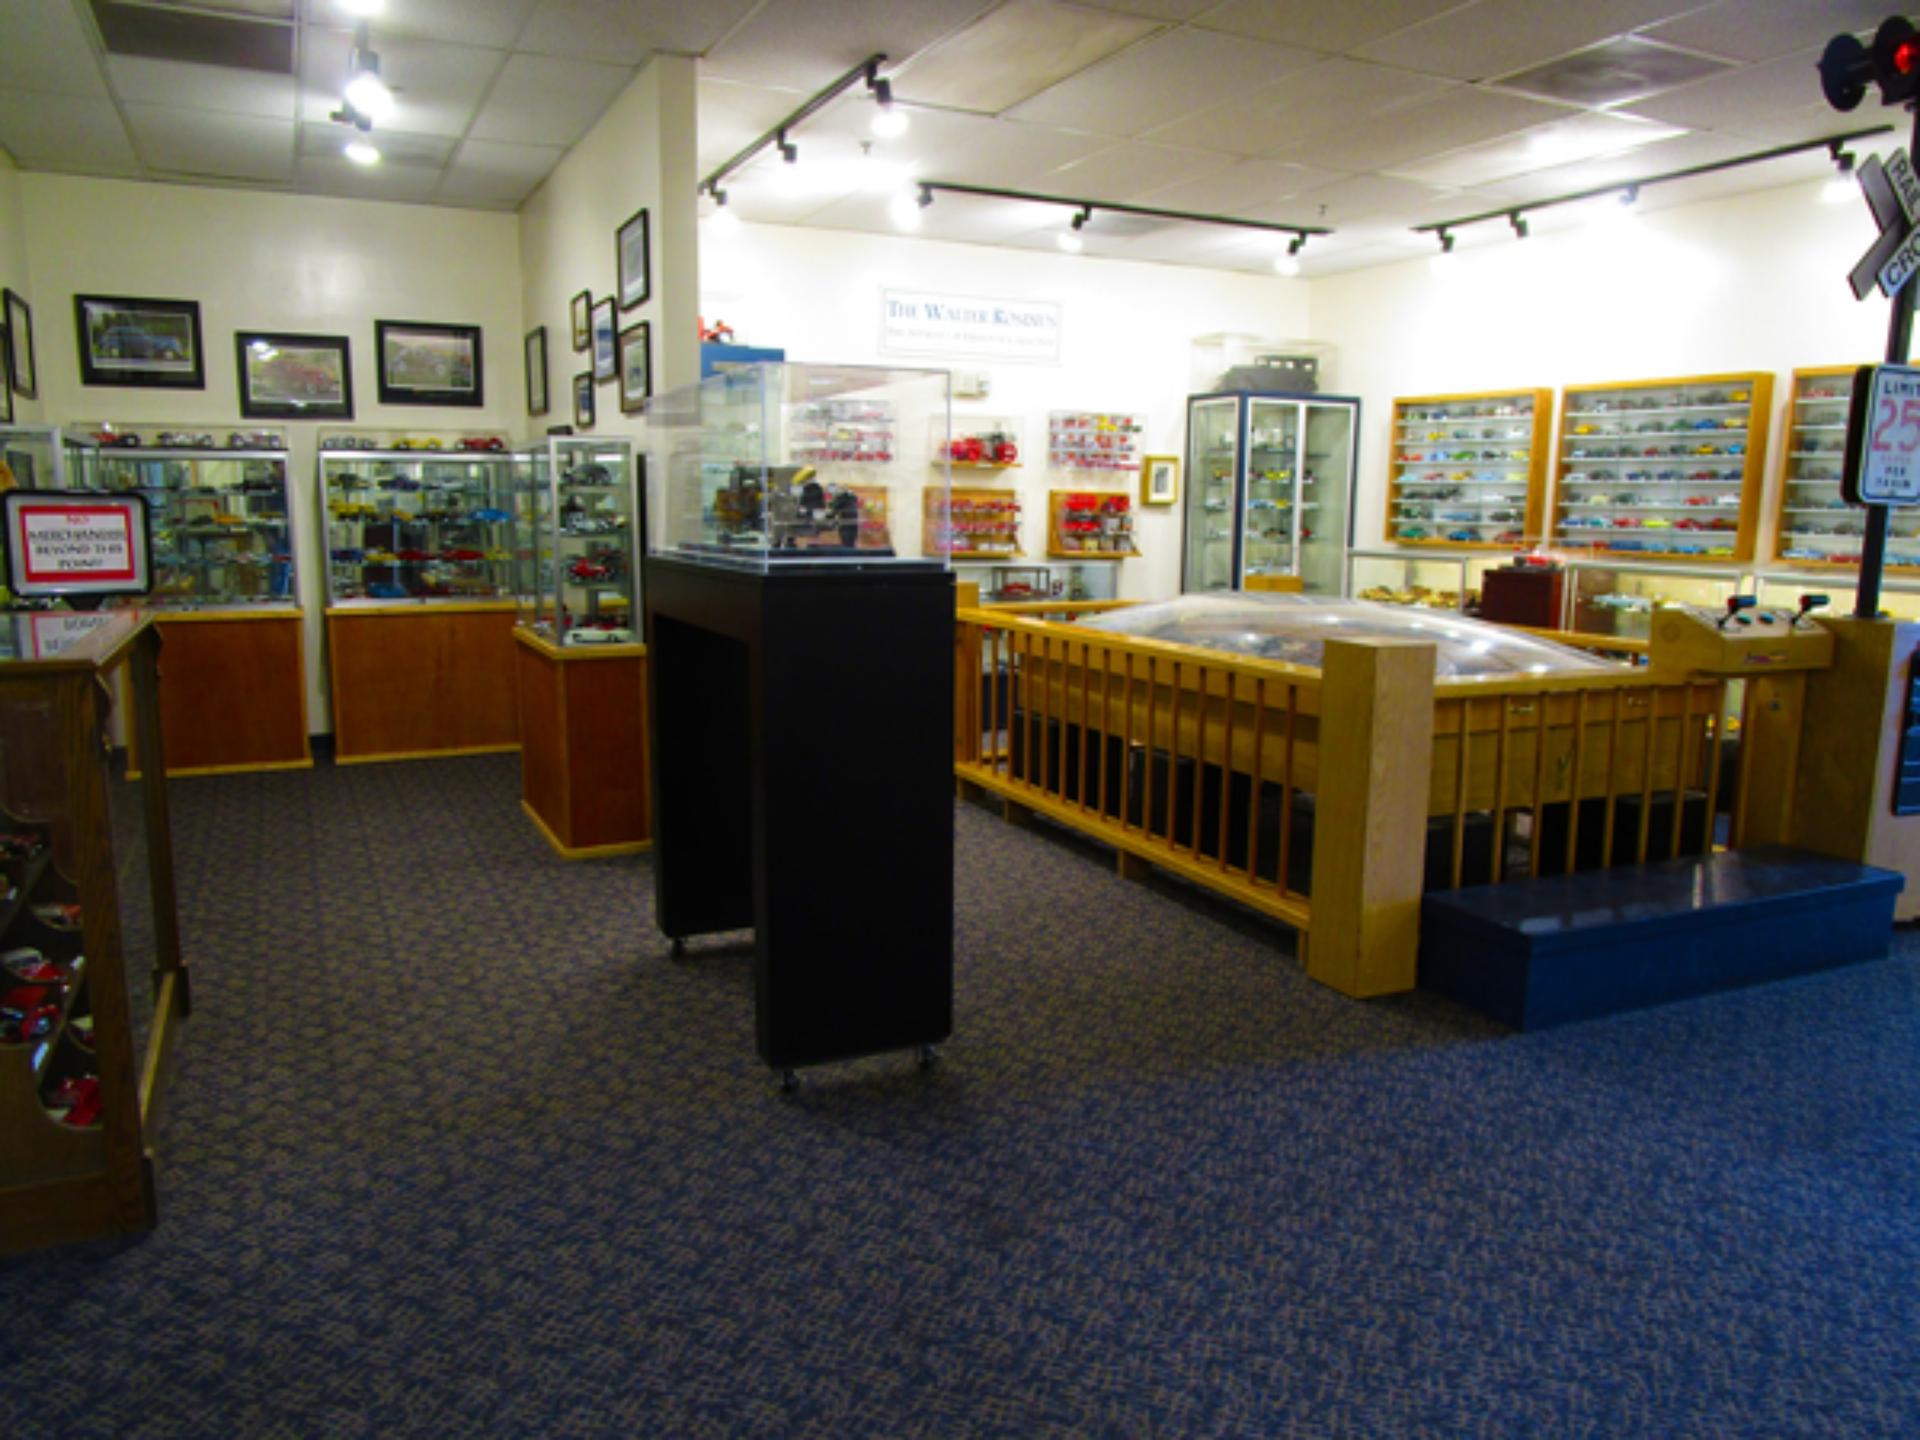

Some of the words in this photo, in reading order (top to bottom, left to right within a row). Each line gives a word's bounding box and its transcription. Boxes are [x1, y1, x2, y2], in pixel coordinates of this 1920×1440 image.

[888, 300, 917, 318] THE
[924, 303, 988, 322] WALTER
[1872, 397, 1920, 452] 25
[35, 544, 90, 555] BEYOND
[95, 543, 123, 554] THIS
